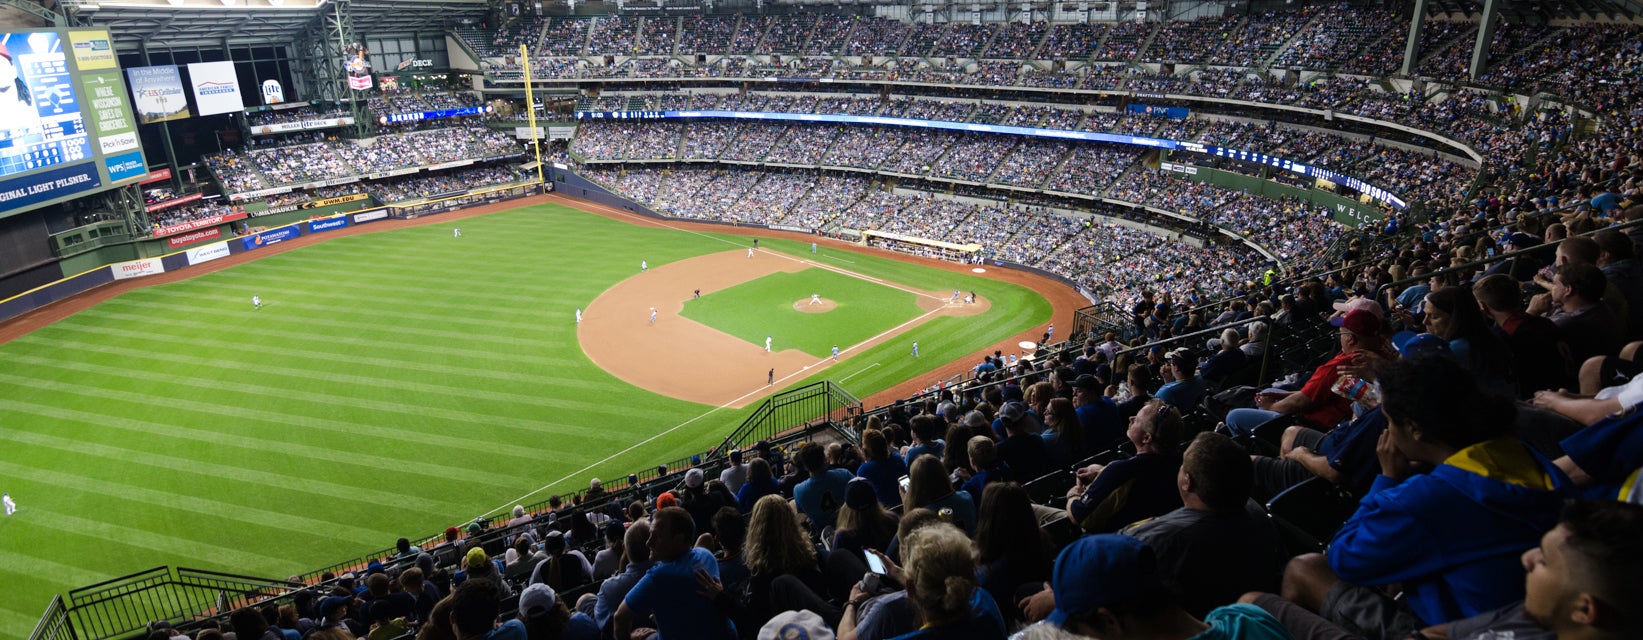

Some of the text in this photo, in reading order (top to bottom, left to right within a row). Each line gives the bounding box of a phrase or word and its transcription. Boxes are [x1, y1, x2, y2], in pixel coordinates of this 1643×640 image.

[264, 84, 280, 96] Lite
[1153, 106, 1170, 115] PNC
[120, 138, 135, 146] Save
[108, 163, 124, 174] WPS
[28, 182, 54, 196] LIGHT
[55, 174, 91, 188] PILSNER.
[323, 195, 355, 206] UWM.EDU
[167, 216, 223, 233] TOYOTA TERRITORY
[313, 221, 341, 231] Southwest
[171, 229, 218, 244] buyatoyota.com
[122, 261, 151, 272] meijer
